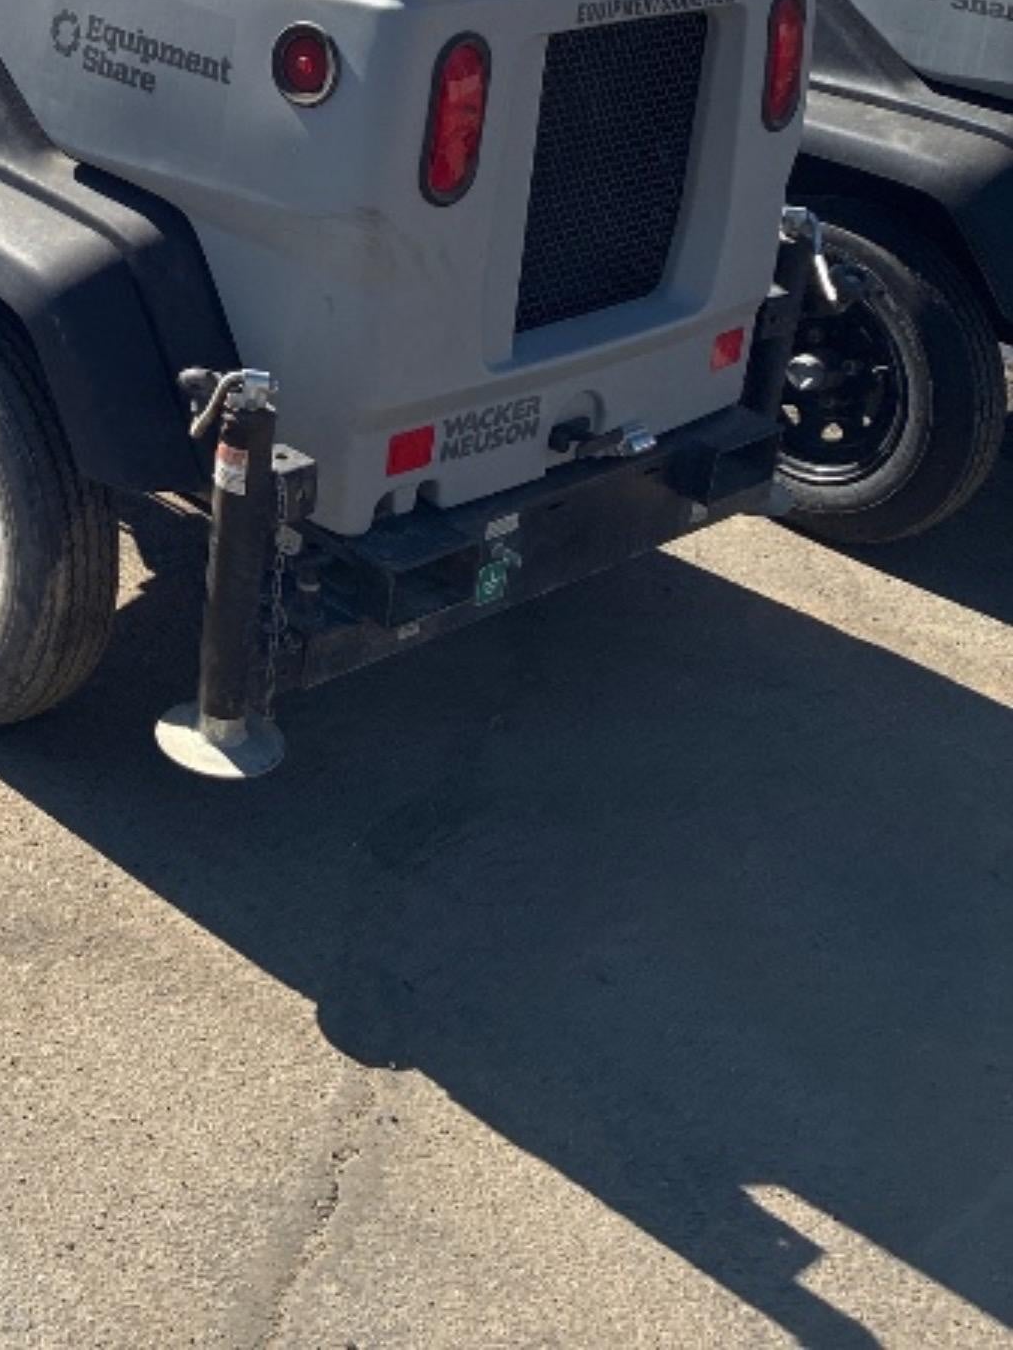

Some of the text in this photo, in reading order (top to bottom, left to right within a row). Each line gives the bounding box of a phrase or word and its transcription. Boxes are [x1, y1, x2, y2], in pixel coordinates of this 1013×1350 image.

[82, 45, 157, 94] Share
[85, 14, 233, 86] Equipment
[439, 417, 541, 463] NEUSON
[443, 394, 542, 440] WACKER
